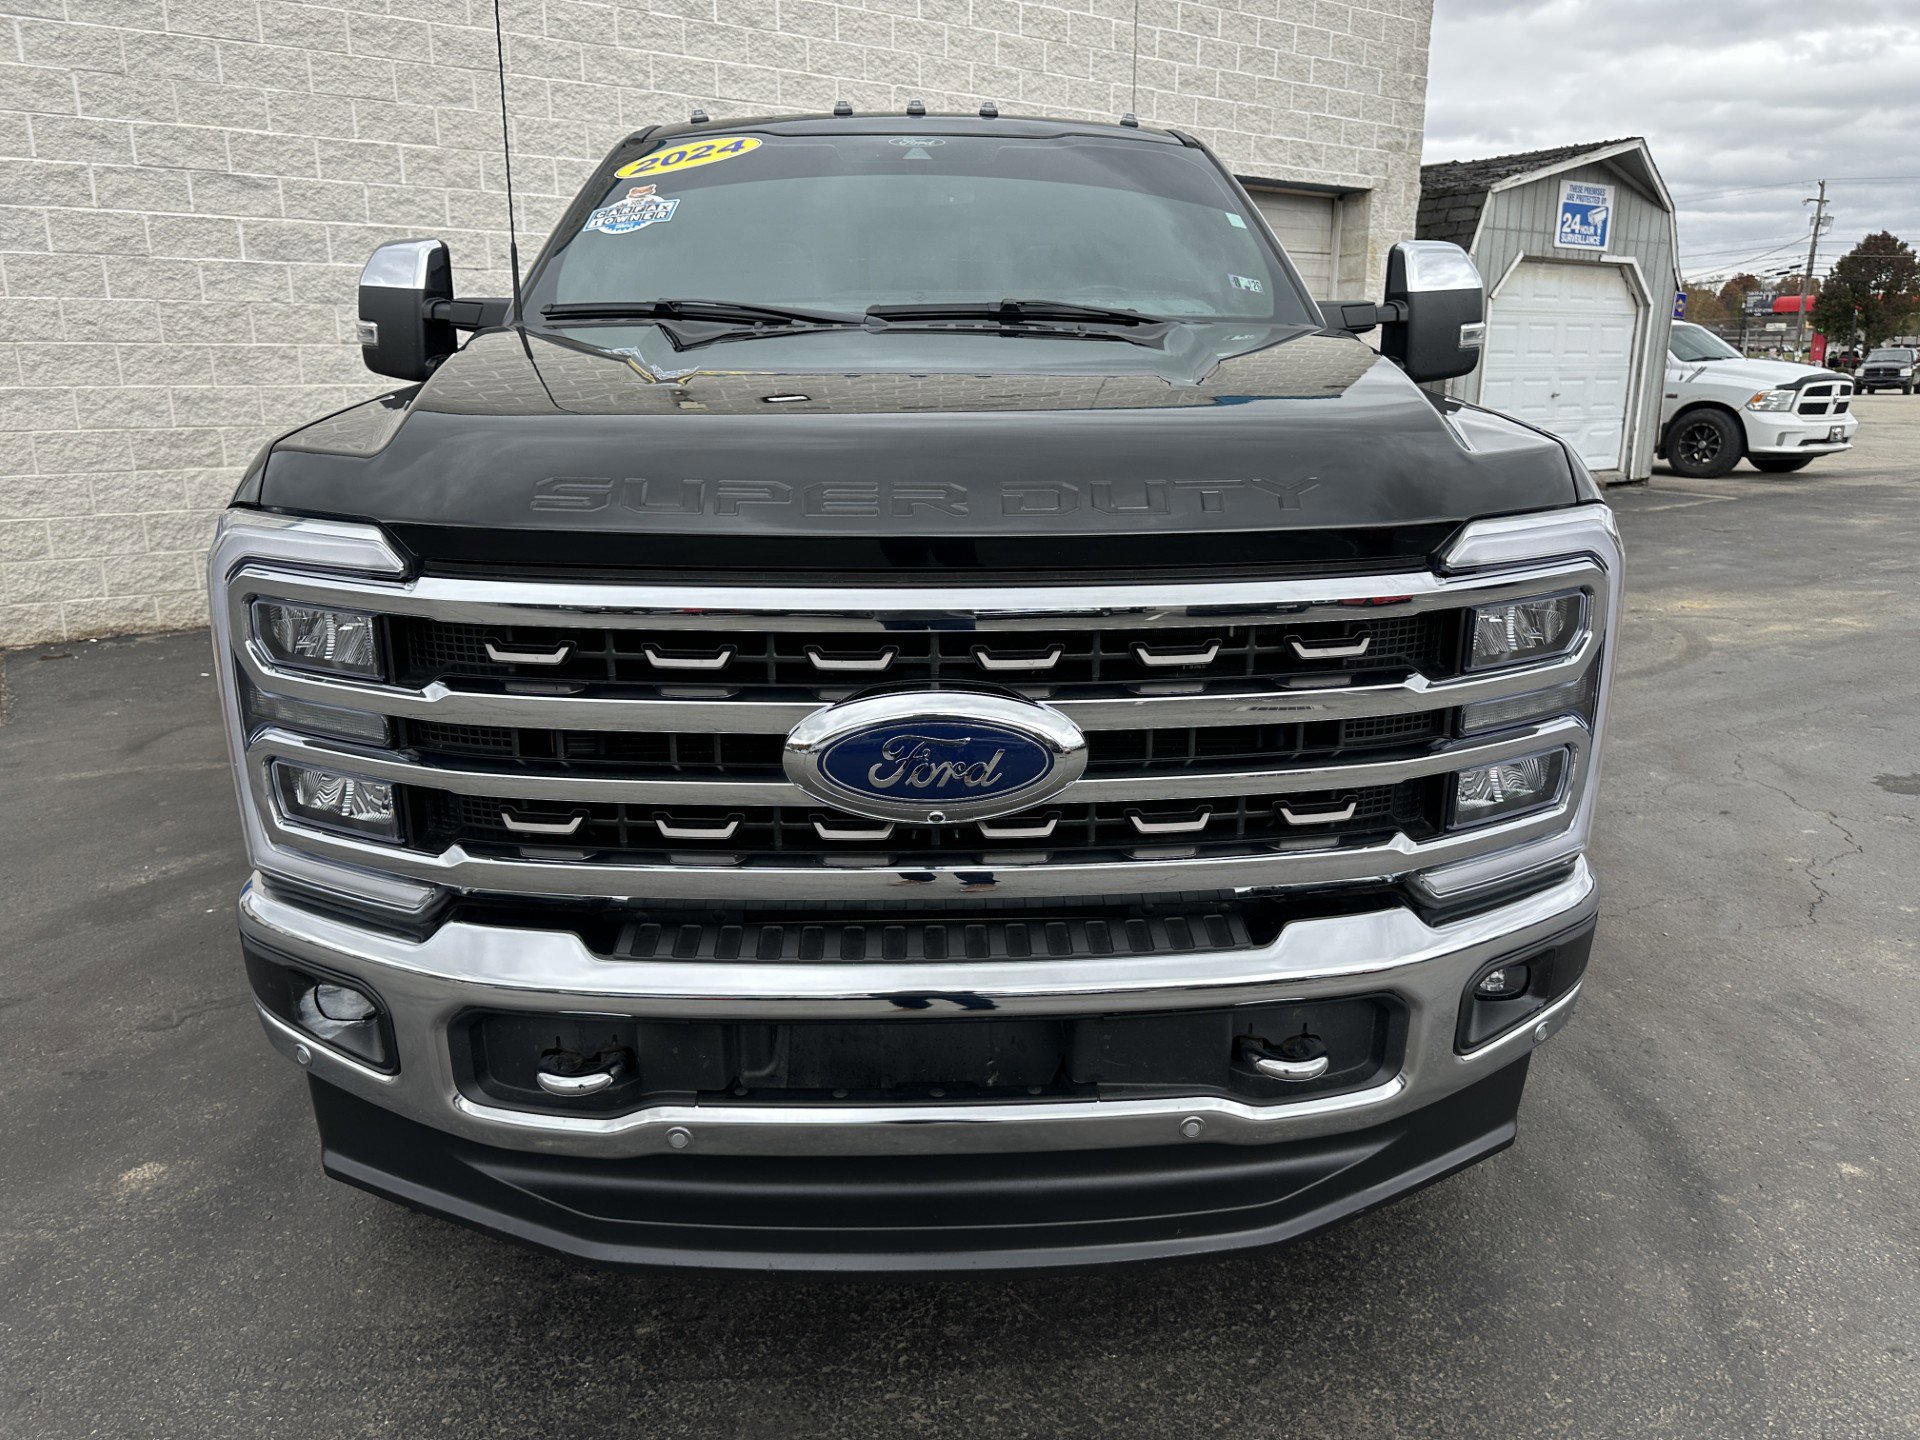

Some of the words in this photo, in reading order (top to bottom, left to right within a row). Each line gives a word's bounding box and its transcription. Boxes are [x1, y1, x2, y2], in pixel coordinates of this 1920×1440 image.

[629, 139, 746, 175] 2024
[1569, 184, 1584, 194] THESE
[1584, 186, 1606, 197] PREMISES
[596, 204, 670, 219] CARFAX
[1561, 212, 1581, 234] 24
[1580, 225, 1595, 235] HOUR
[1560, 233, 1601, 245] SURVEILLANCE
[530, 476, 970, 517] SUPER
[999, 475, 1321, 517] DUTY
[868, 734, 1006, 789] Ford
